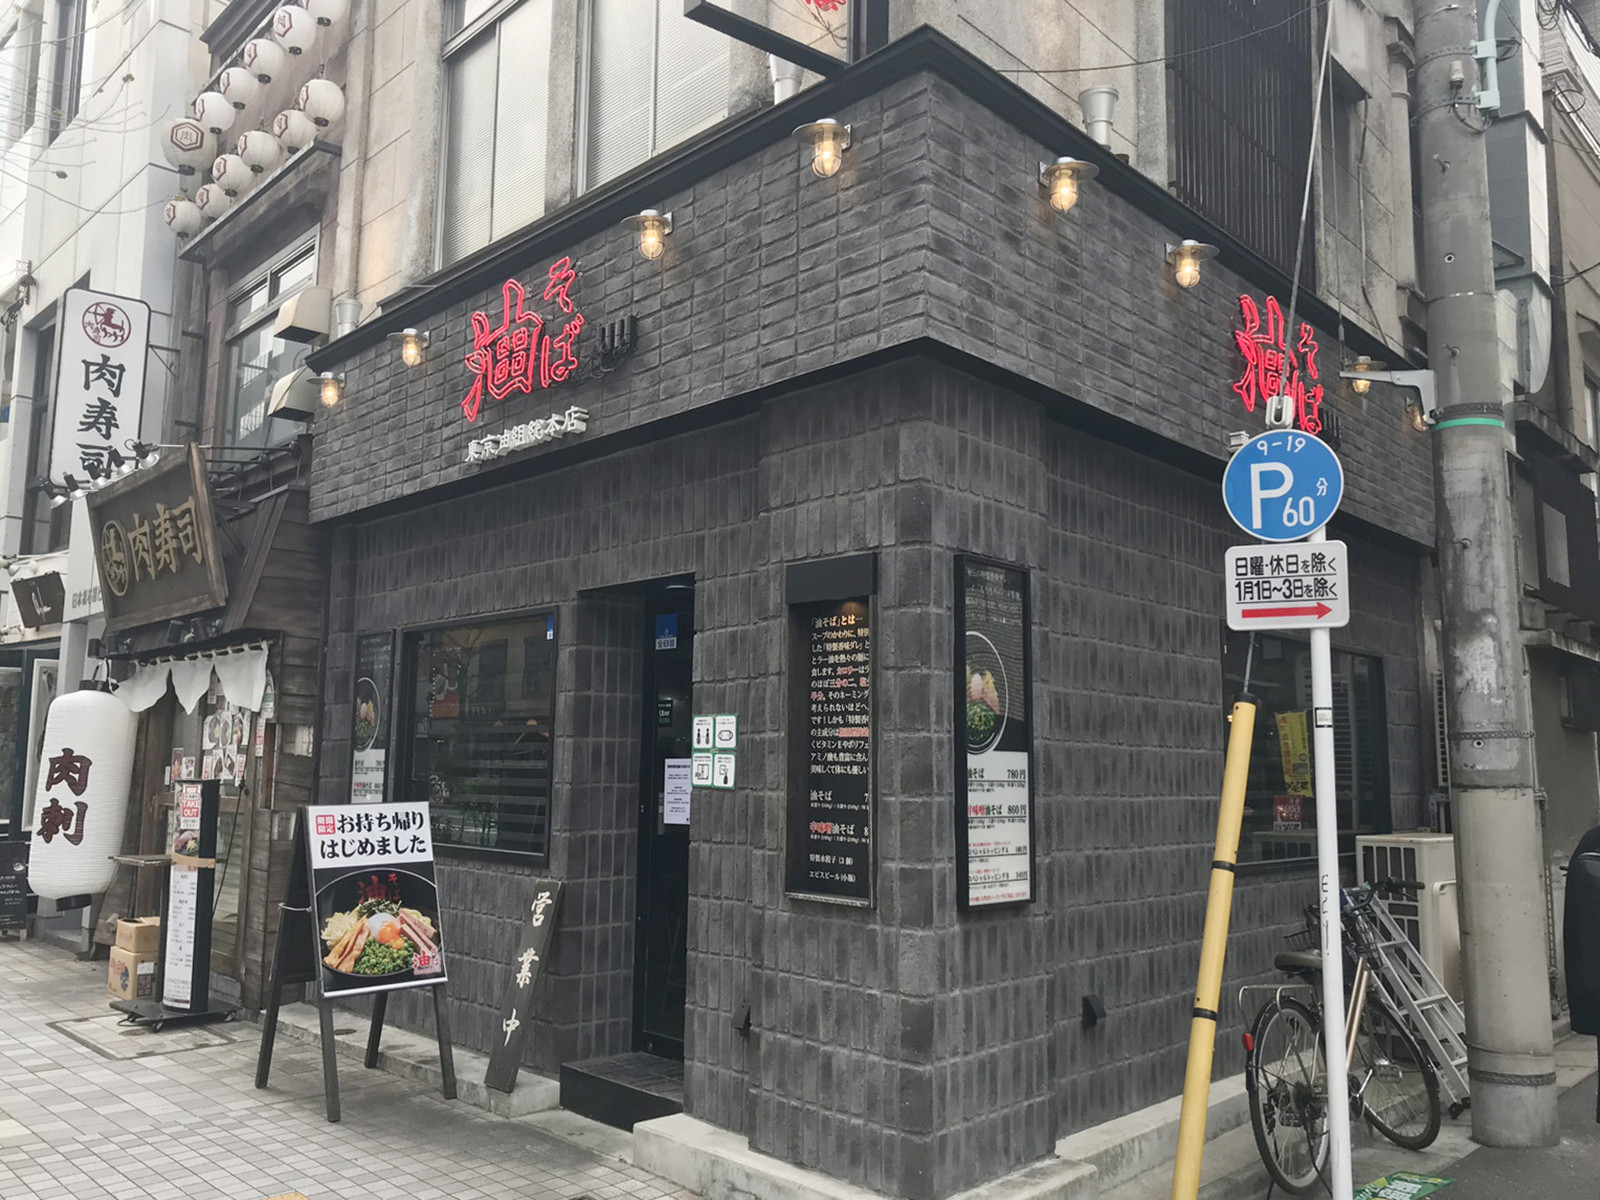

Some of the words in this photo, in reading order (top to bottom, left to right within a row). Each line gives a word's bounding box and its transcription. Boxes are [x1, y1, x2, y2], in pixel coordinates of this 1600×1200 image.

[76, 353, 126, 480] 肉寿司
[465, 405, 590, 464] 東京油組総本店
[1257, 437, 1306, 456] 9-19
[1250, 462, 1294, 530] P
[1282, 496, 1315, 526] 60
[1316, 477, 1328, 496] 分
[128, 496, 203, 582] 肉寿司
[37, 747, 92, 846] 肉刺
[182, 800, 200, 808] TAKE
[183, 808, 198, 817] OUT
[337, 811, 424, 834] お持ち帰り
[321, 834, 427, 859] はじめました
[502, 891, 552, 1046] 営業中
